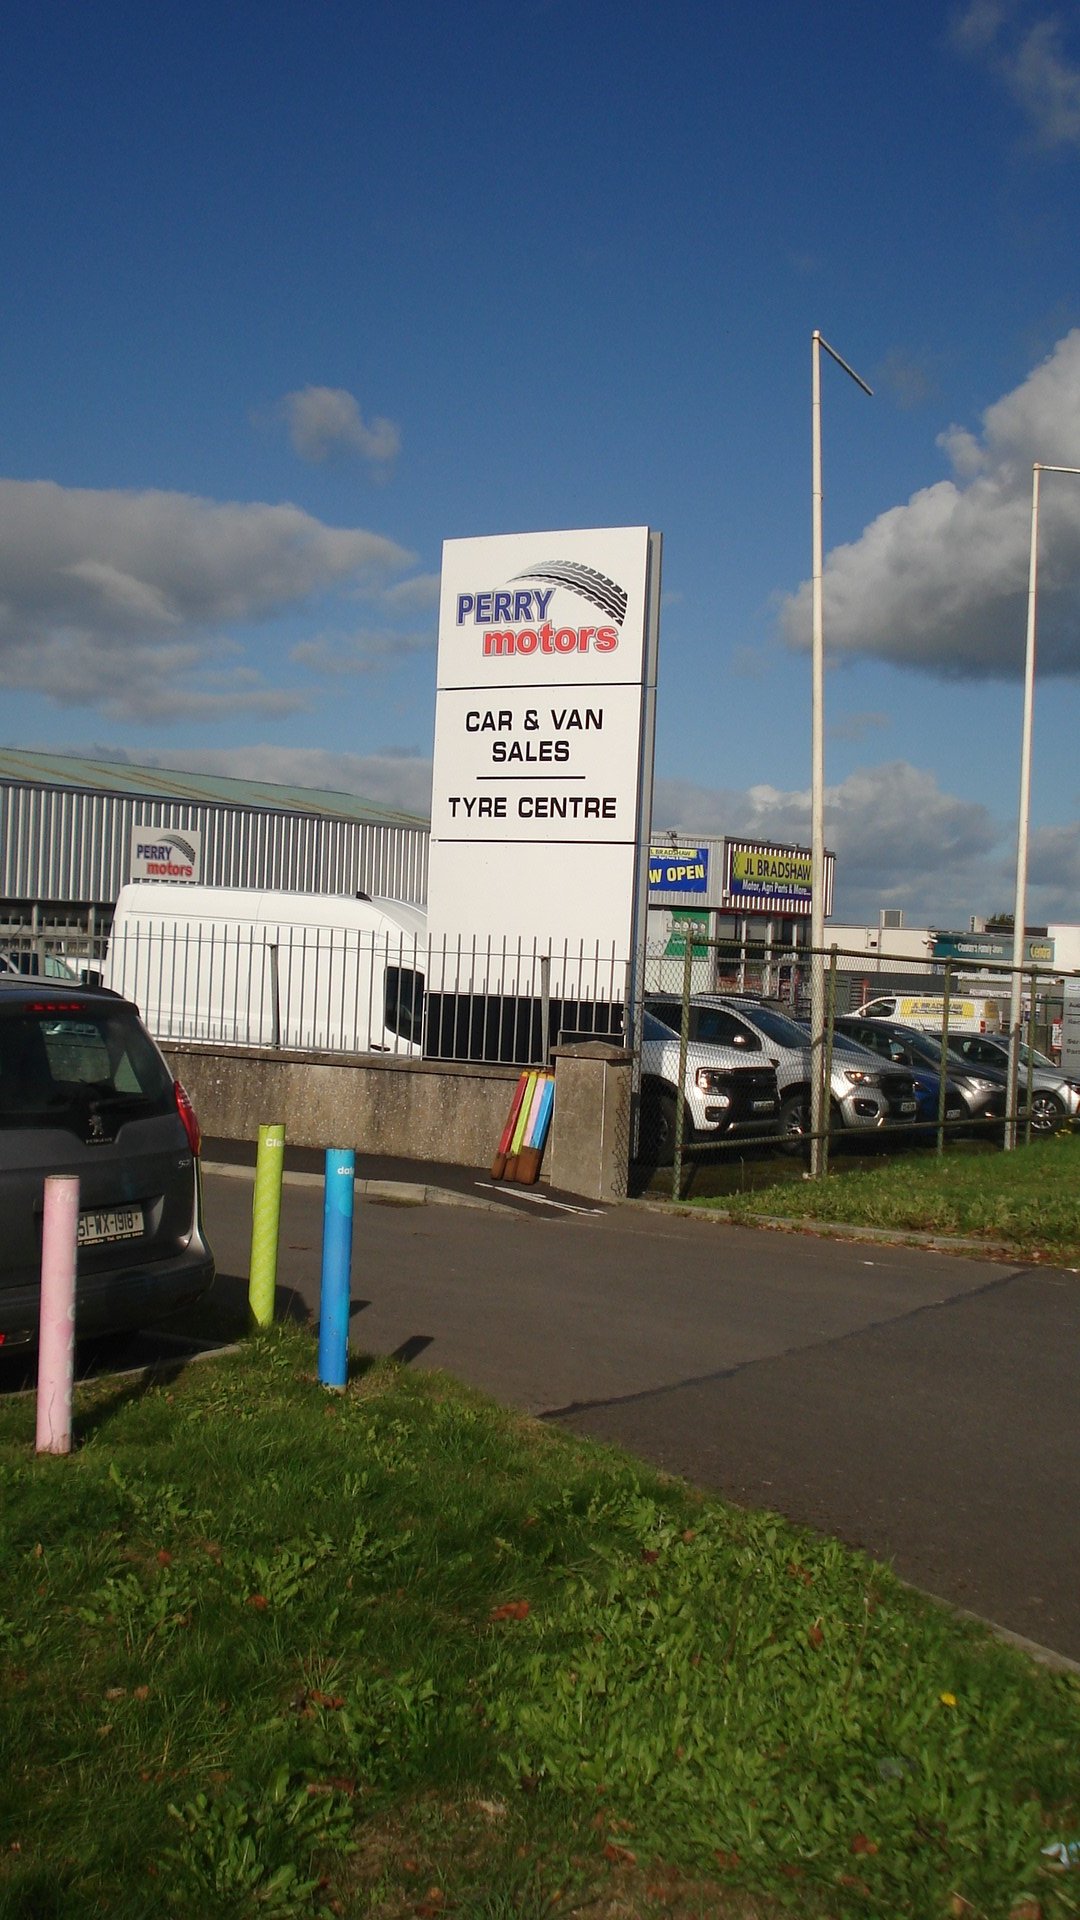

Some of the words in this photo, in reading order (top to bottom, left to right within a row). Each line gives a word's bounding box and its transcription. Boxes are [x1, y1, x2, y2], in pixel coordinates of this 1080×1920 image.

[456, 588, 555, 626] PERRY
[483, 620, 618, 656] motors
[466, 710, 513, 732] CAR
[523, 709, 540, 731] &
[551, 708, 604, 731] VAN
[492, 740, 570, 762] SALES
[448, 797, 507, 818] TYRE
[518, 797, 617, 818] CENTRE
[137, 843, 173, 860] PERRY
[146, 861, 193, 877] motors
[666, 864, 705, 882] OPEN
[744, 858, 755, 876] JL
[757, 859, 812, 881] BRADSHAW
[761, 880, 774, 895] Agri
[265, 1138, 284, 1147] Cle
[337, 1166, 355, 1175] dat
